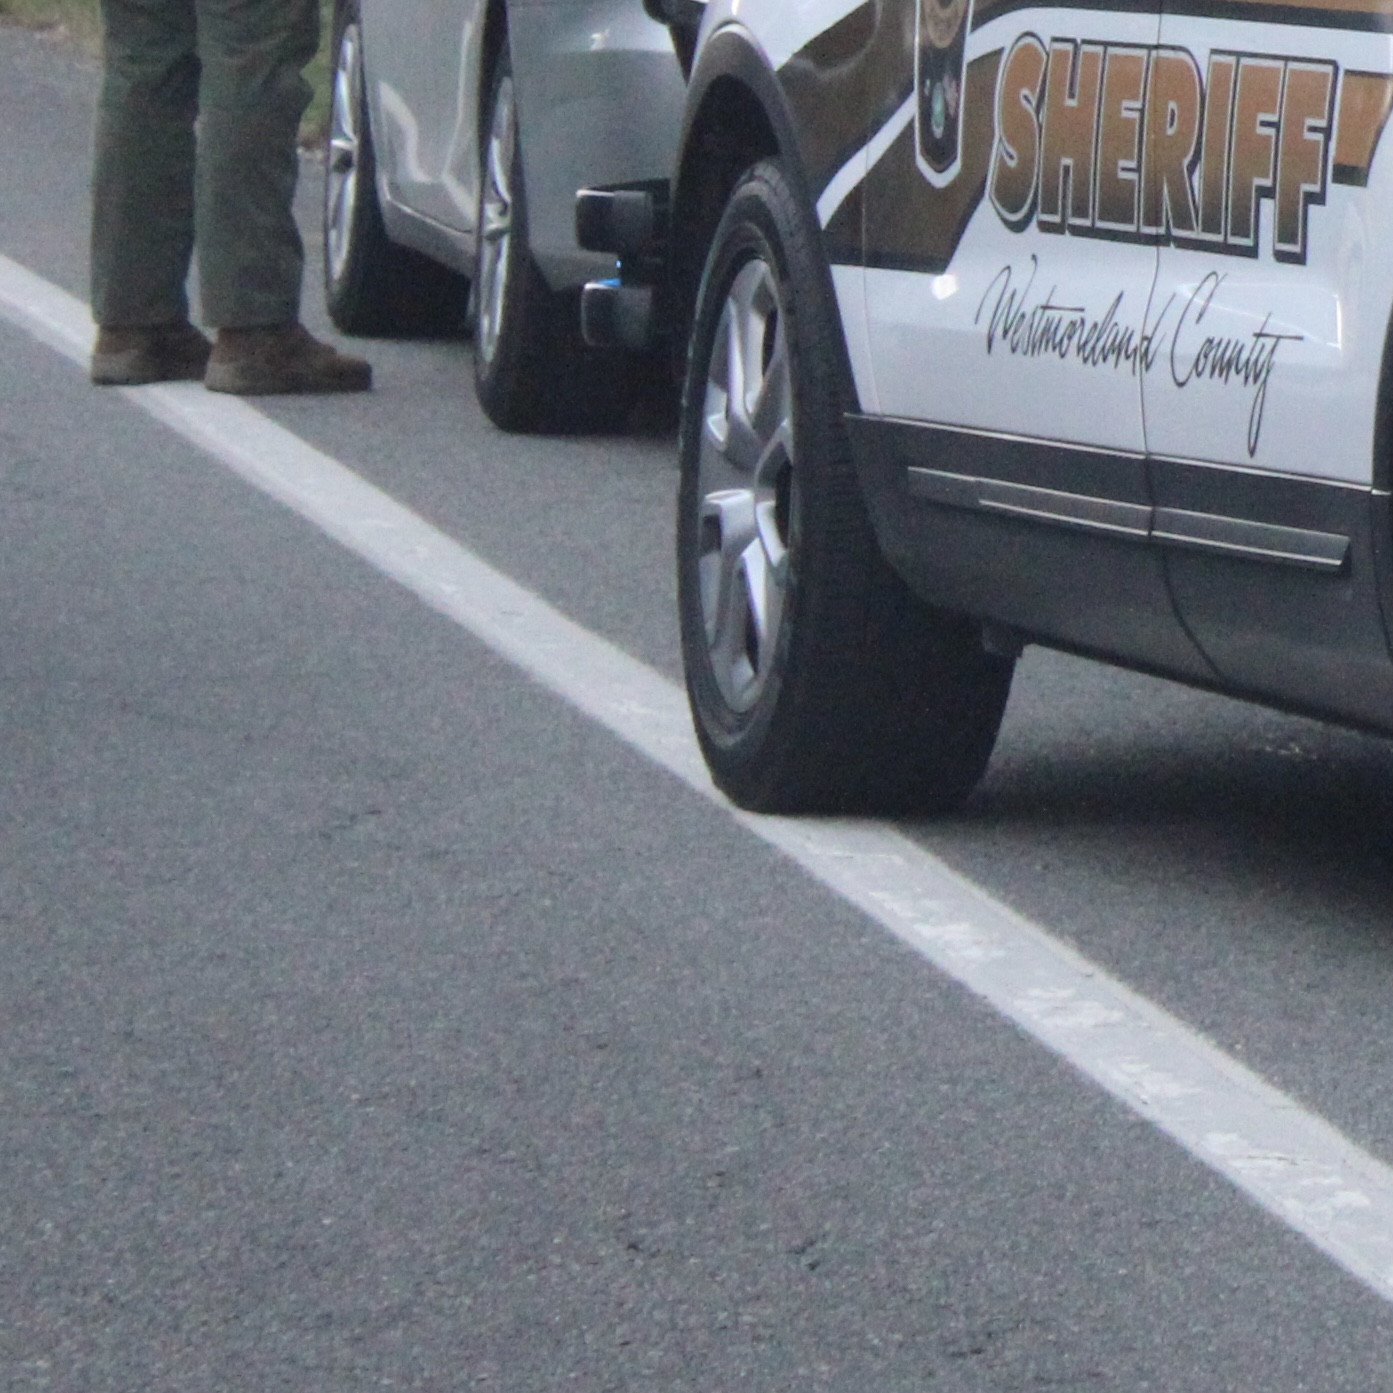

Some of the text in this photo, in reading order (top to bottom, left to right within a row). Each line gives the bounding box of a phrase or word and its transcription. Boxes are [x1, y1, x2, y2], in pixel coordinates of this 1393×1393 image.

[988, 31, 1339, 264] SHERIFF
[975, 253, 1304, 457] Westmoreland County
